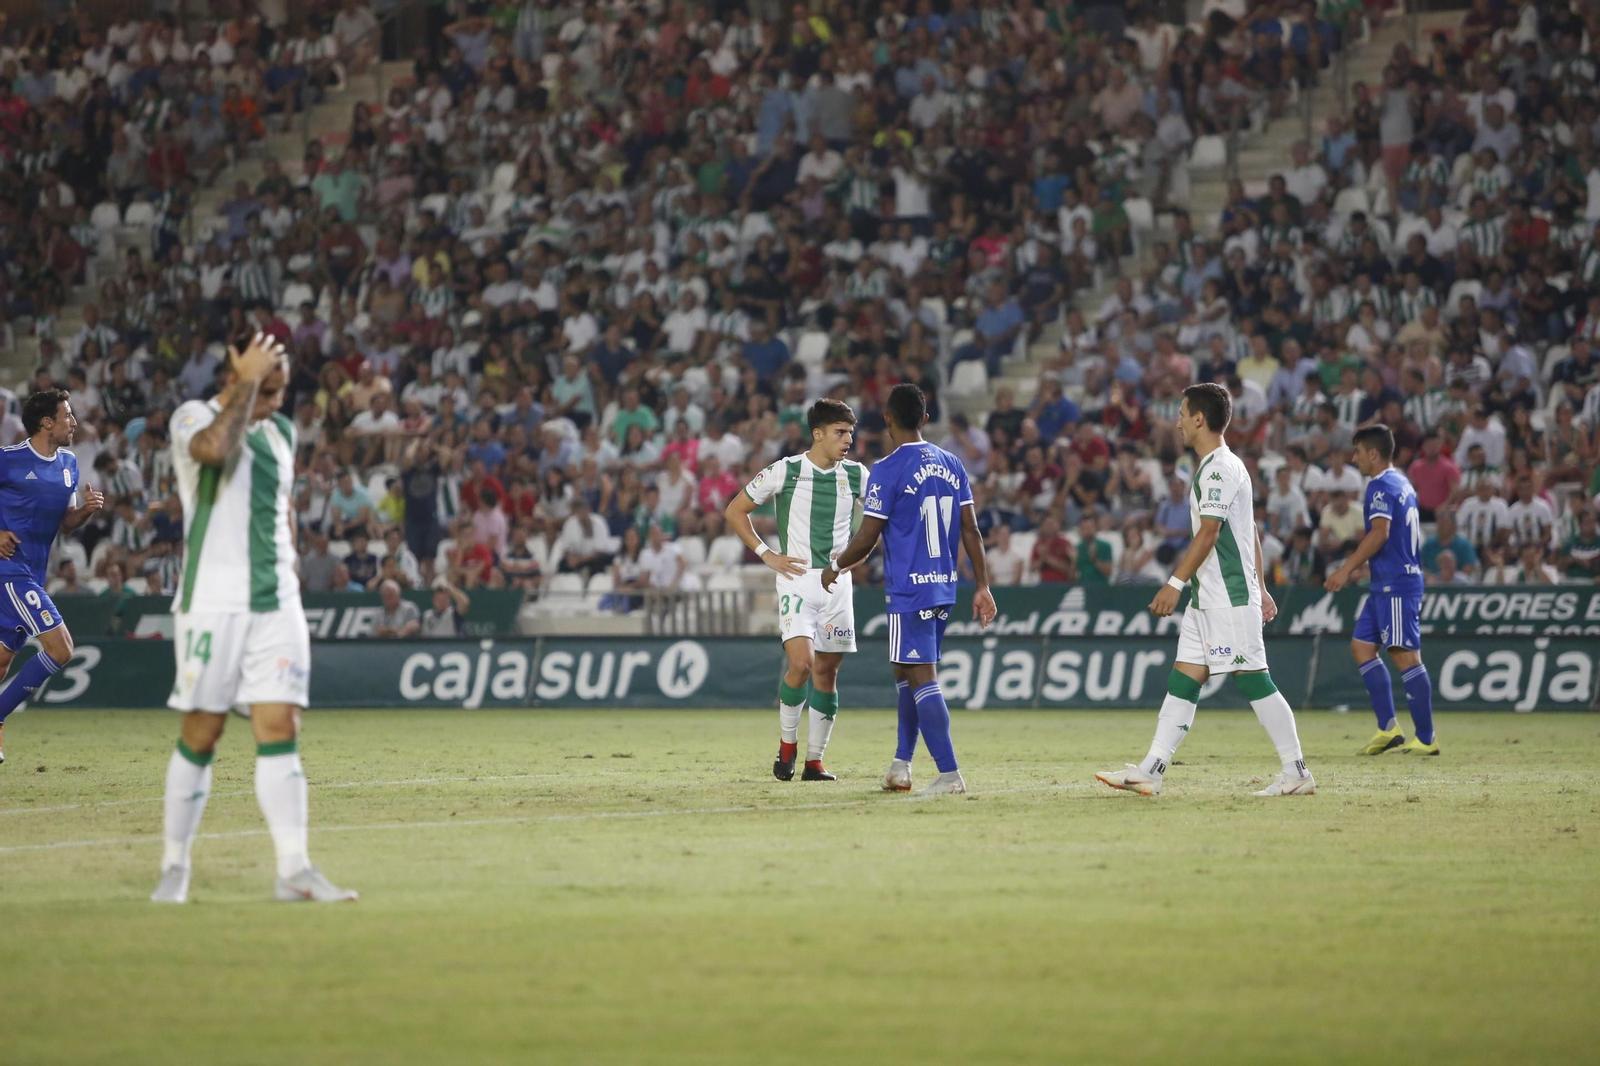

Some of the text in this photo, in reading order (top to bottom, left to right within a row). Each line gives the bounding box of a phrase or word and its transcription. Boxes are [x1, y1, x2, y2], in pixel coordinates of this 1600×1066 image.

[904, 484, 918, 495] Y.
[24, 590, 42, 610] 9
[780, 593, 804, 616] 37
[184, 628, 213, 666] 14
[400, 638, 652, 711] cajasur
[936, 637, 1167, 711] ajasur
